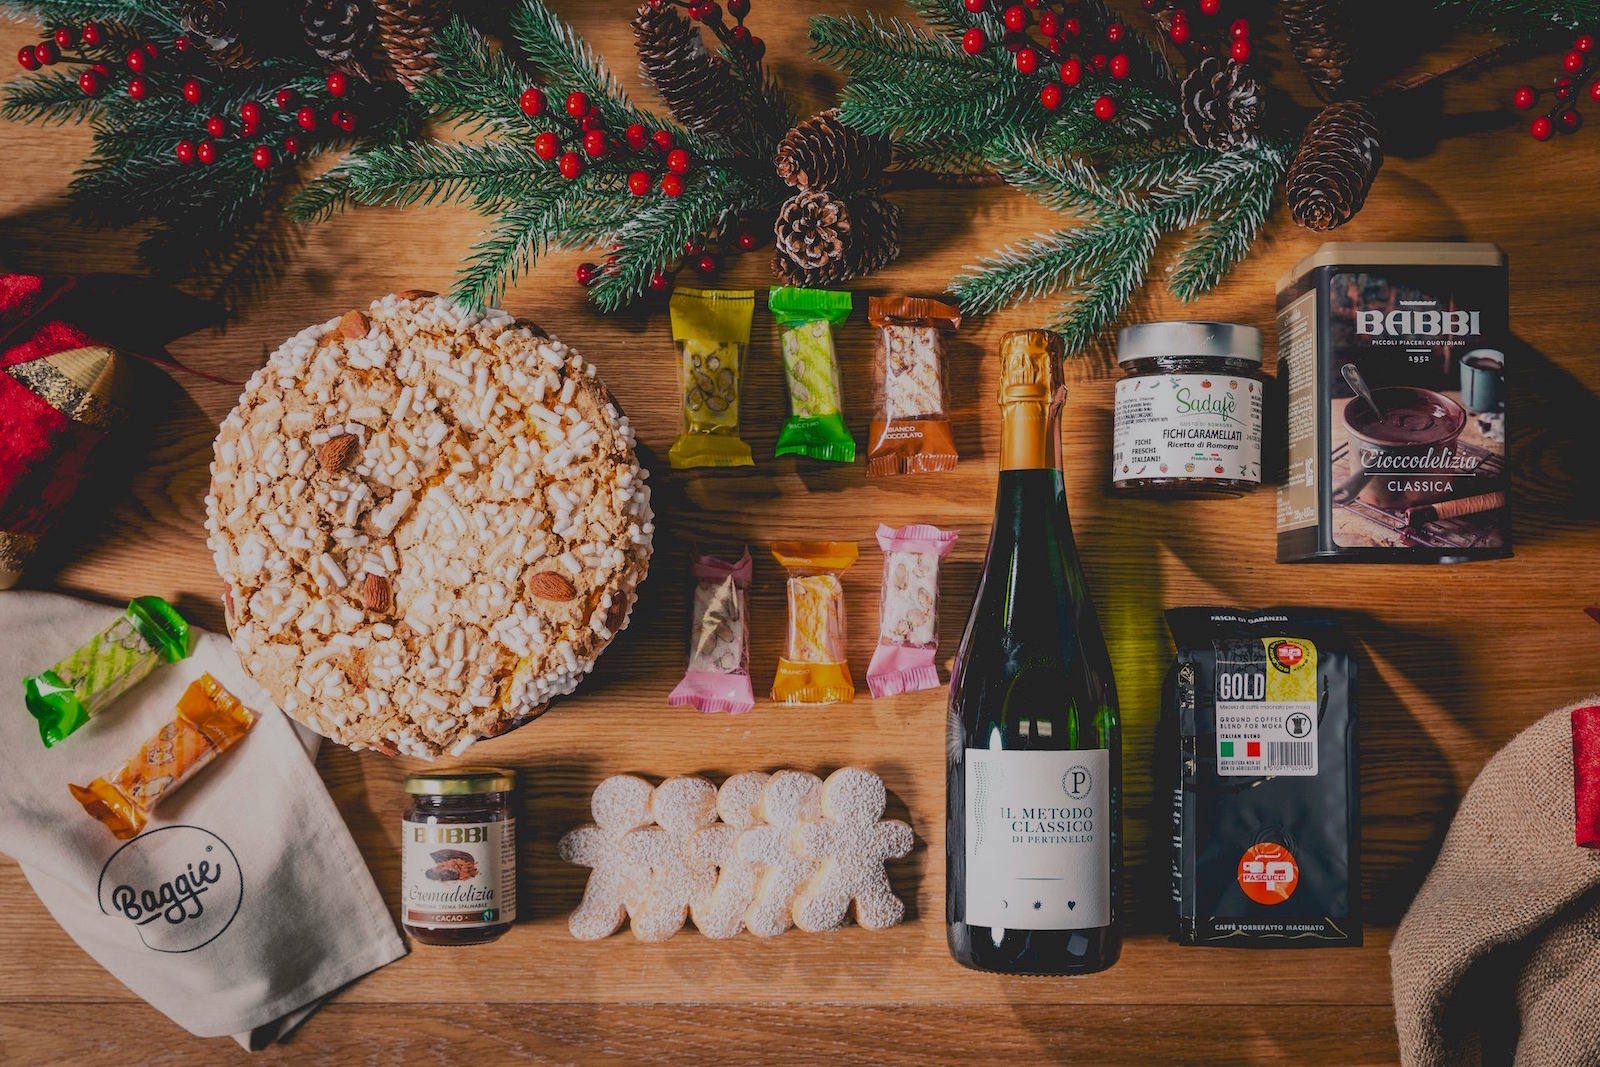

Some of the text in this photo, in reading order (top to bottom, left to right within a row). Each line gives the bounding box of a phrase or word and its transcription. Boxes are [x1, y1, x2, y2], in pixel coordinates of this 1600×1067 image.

[1355, 310, 1481, 336] BABBI
[1177, 387, 1237, 421] Sadafè
[1162, 429, 1186, 440] FICHI
[1187, 429, 1242, 441] CARAMELLATI
[1135, 438, 1151, 446] FICHI
[1206, 441, 1239, 450] Romagna
[1132, 447, 1156, 455] FRESCHI
[1360, 446, 1480, 470] Cioccodelizia
[1387, 481, 1454, 492] CLASSICA
[1247, 615, 1288, 624] GARANZIA
[1220, 672, 1265, 700] GOLD
[1072, 771, 1086, 794] P
[1001, 807, 1093, 819] IL METODO
[1012, 820, 1093, 833] CLASSICO
[1012, 835, 1093, 844] DI PERTINELLO
[112, 860, 221, 924] Baggie
[409, 884, 495, 902] Cremadelizia
[435, 914, 463, 922] CACAO
[1214, 922, 1236, 931] CAFFÈ
